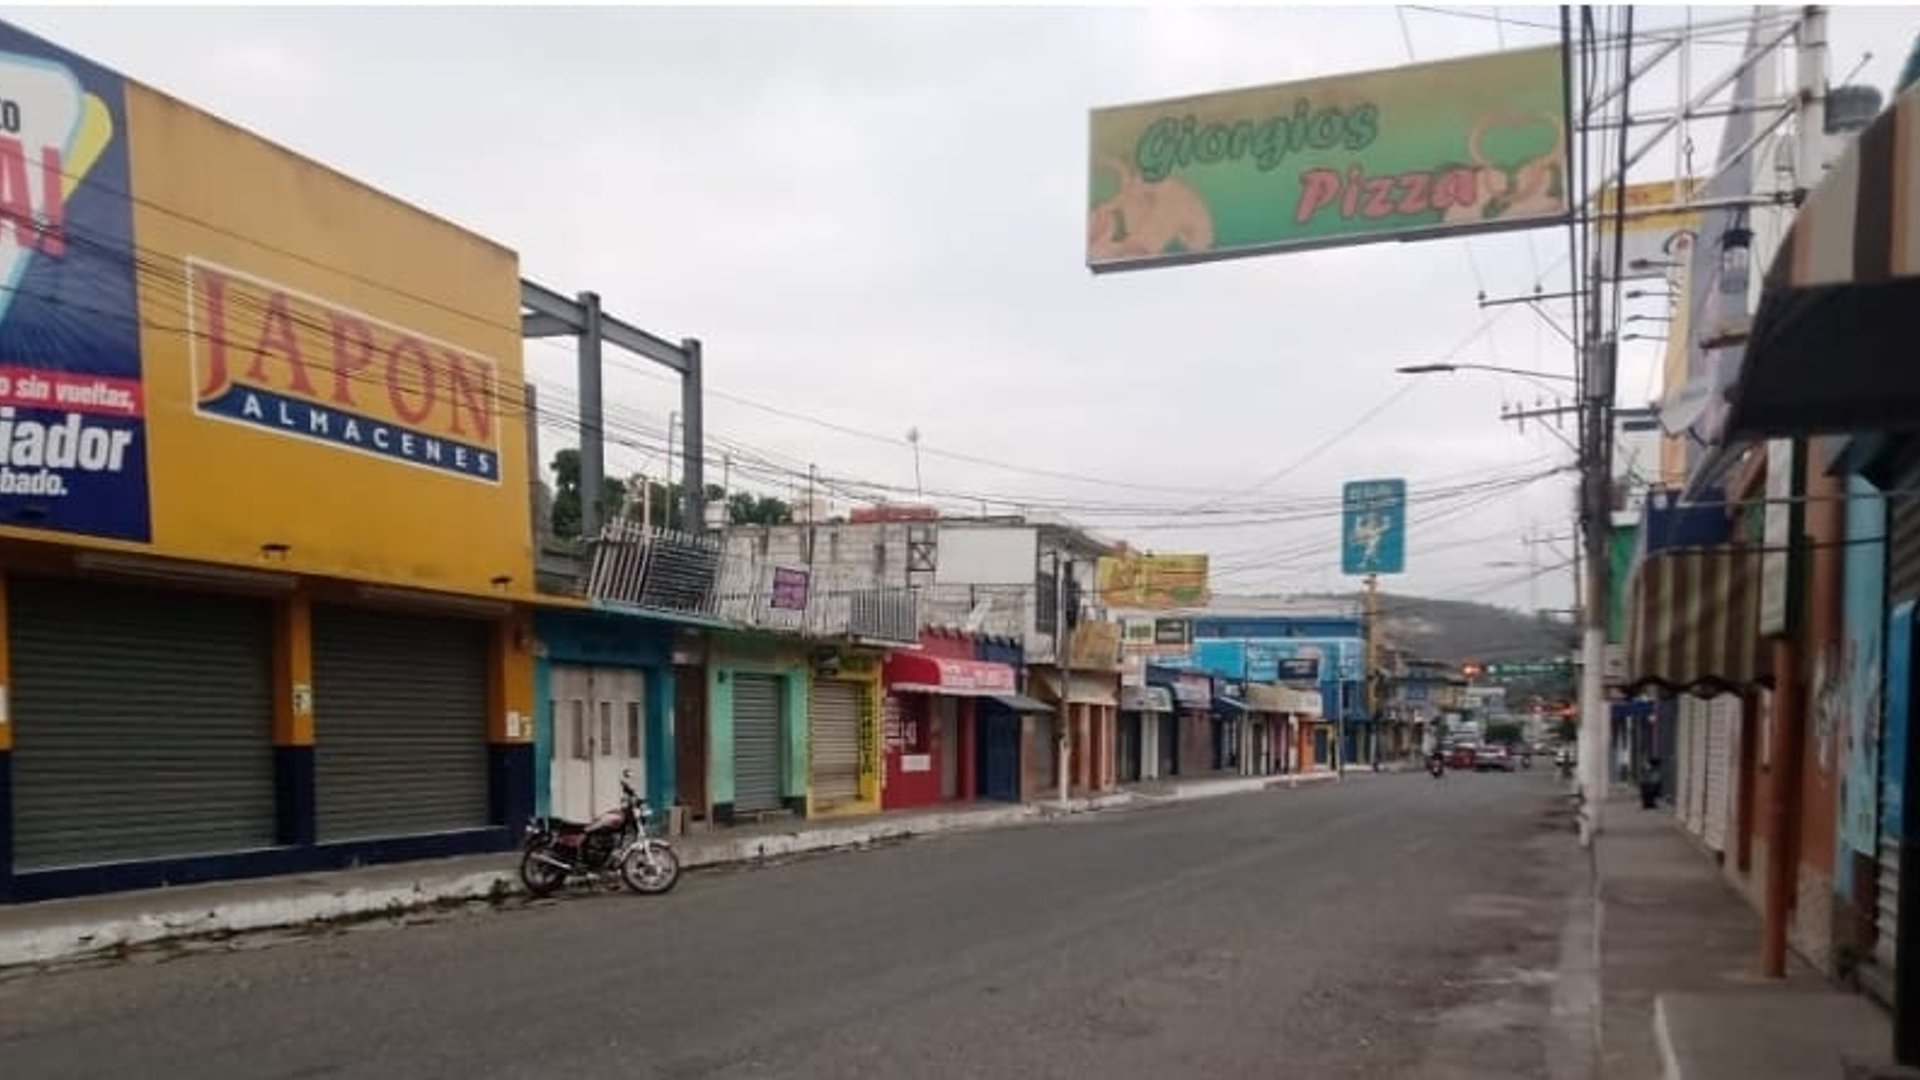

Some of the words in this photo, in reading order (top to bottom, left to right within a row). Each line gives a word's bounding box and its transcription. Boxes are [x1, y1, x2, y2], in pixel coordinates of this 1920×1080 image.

[1137, 99, 1381, 181] Giorgios
[1294, 162, 1479, 226] Pizza
[16, 374, 49, 400] sin
[200, 269, 493, 442] JAPON
[242, 393, 490, 473] ALMACENES
